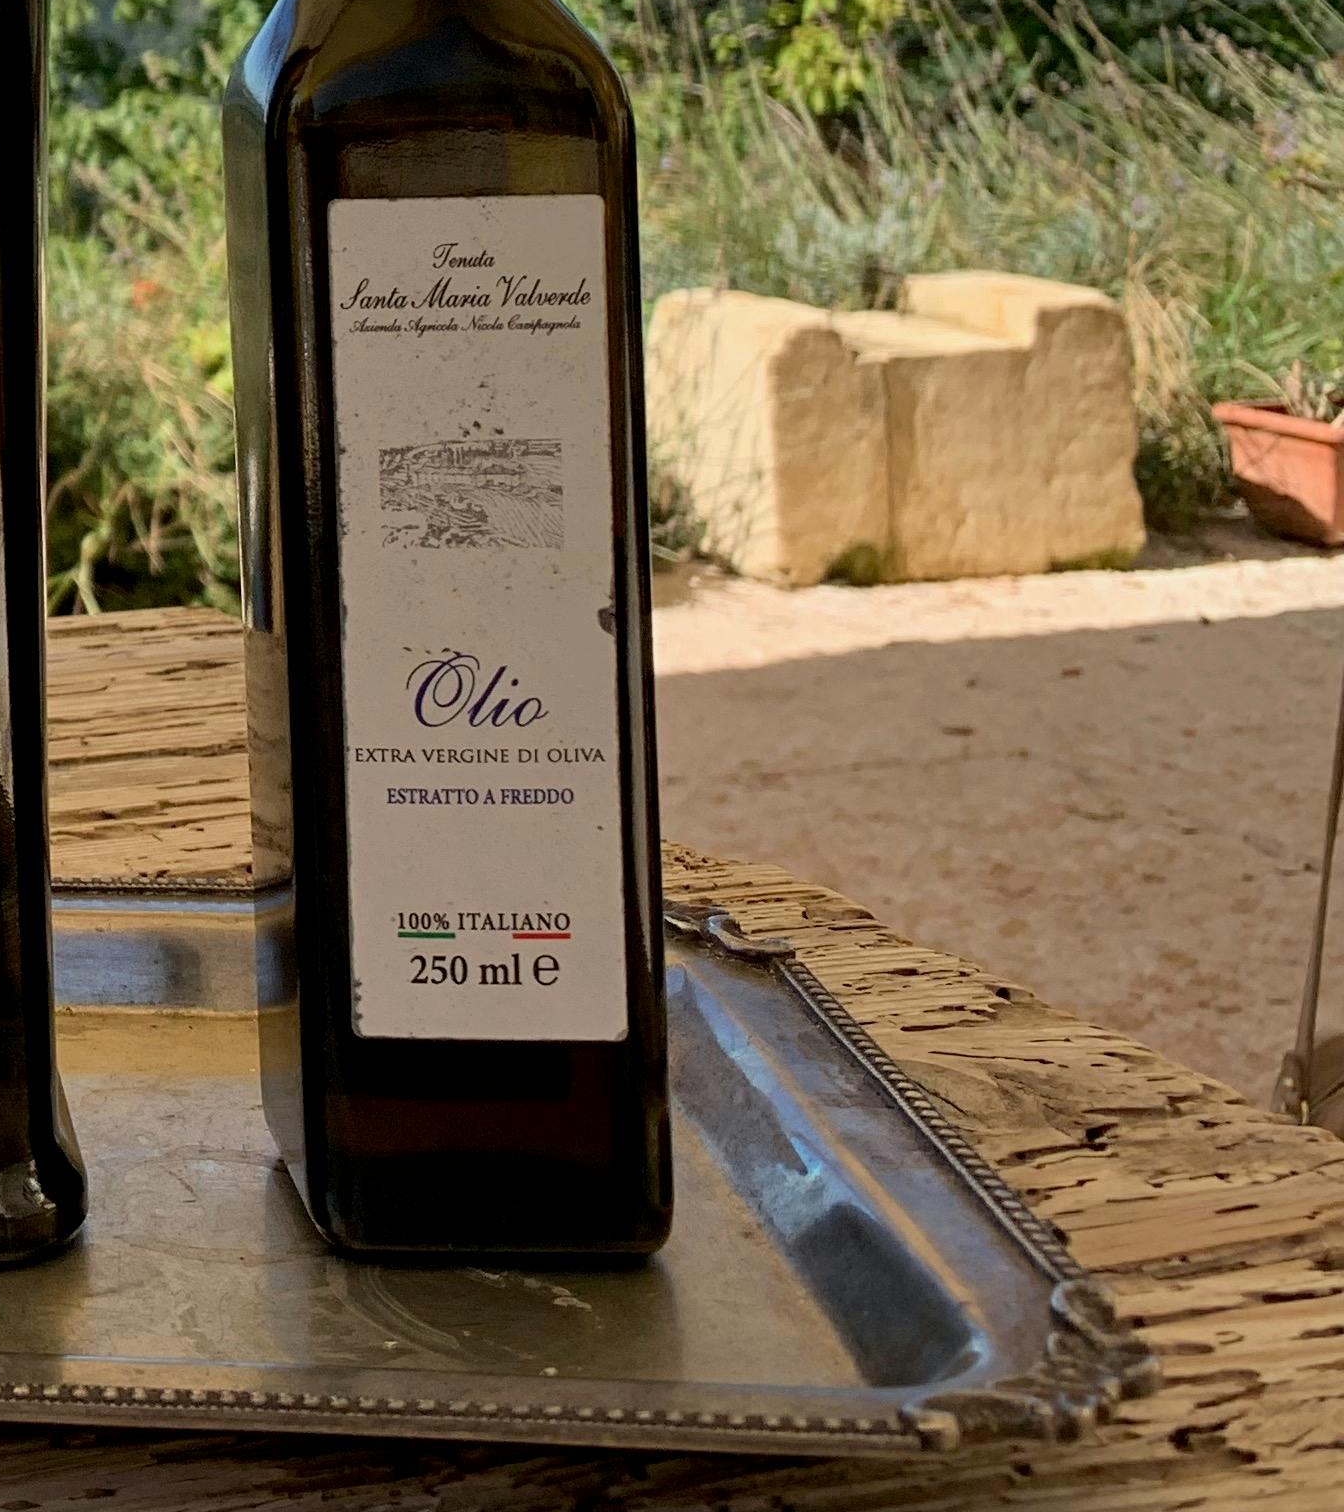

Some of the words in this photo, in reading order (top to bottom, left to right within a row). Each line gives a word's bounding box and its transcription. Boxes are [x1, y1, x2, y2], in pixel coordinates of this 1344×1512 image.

[432, 242, 496, 269] Tenuta
[340, 278, 408, 310] Santa
[411, 277, 491, 309] Maria
[496, 275, 591, 307] Valverde
[349, 318, 401, 333] Azienda
[402, 316, 458, 337] Agricola
[461, 315, 504, 331] Nicola
[507, 314, 581, 335] Campagnola
[406, 654, 549, 727] Olio
[355, 748, 415, 763] EXTRA
[421, 747, 509, 764] VERGINE
[518, 748, 538, 763] DI
[547, 747, 605, 763] OLIVA
[387, 788, 479, 805] ESTRATTO
[483, 789, 496, 805] A
[501, 788, 574, 805] FREDDO
[397, 912, 450, 930] 100%
[457, 912, 570, 931] ITALIANO
[410, 955, 468, 985] 250
[478, 953, 522, 985] ml
